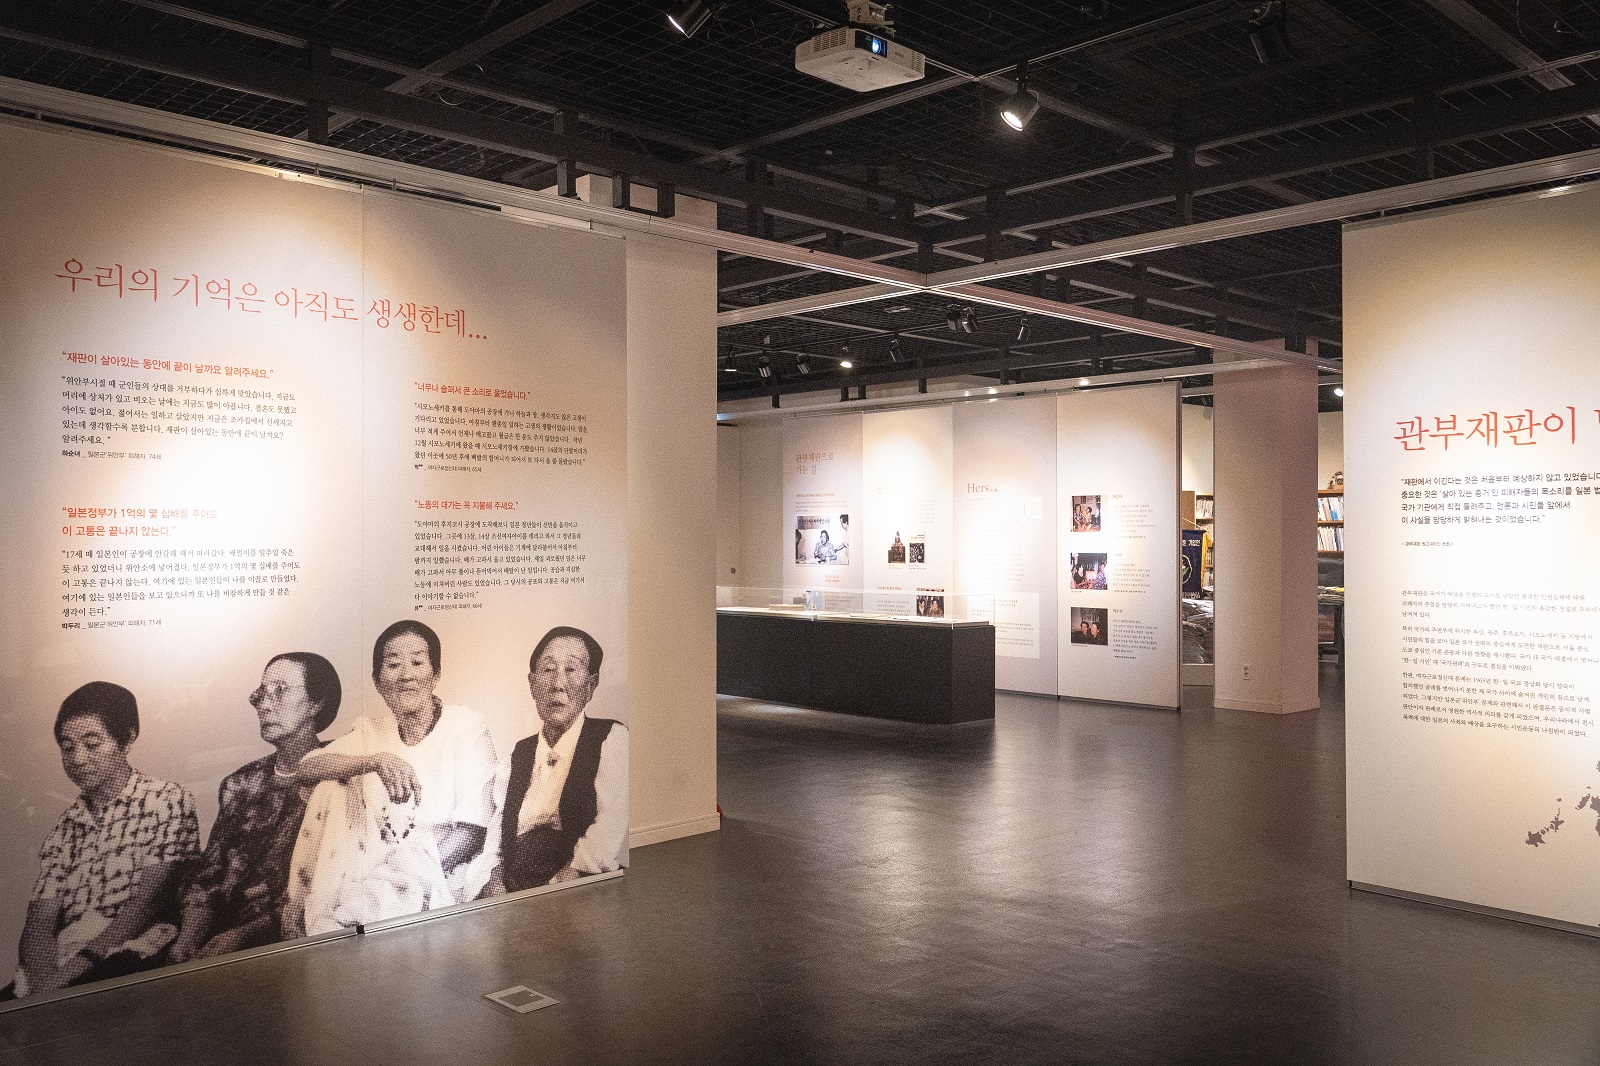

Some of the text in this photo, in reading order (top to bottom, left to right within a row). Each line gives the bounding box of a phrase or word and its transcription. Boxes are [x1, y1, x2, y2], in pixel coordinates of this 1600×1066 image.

[55, 257, 489, 341] 우리의 기억은 아직도 생생한데...
[62, 351, 273, 379] "재판이 살아있는 동안에 끝이 날까요 알려주세요."
[62, 376, 295, 401] "위안부시절 때 군인들의 상대를 거부하다가 심하게 맞았습니다. 지금도
[415, 382, 530, 400] "너무나 슬퍼서 큰 소리로 울었습니다."
[63, 420, 86, 429] 있는데
[89, 421, 128, 431] 생각할수록
[131, 424, 163, 433] 분합니다.
[166, 426, 187, 434] 재판이
[190, 427, 219, 436] 살아있는
[221, 429, 241, 437] 동안에
[244, 430, 257, 438] 끝이
[1393, 405, 1576, 451] 관부재판이
[62, 434, 105, 445] 알려주세요.
[1401, 478, 1431, 486] "재판에서
[1434, 477, 1461, 485] 이긴다는
[1465, 476, 1478, 484] 것은
[1481, 476, 1510, 484] 처음부터
[1513, 475, 1542, 483] 예상하지
[1546, 474, 1561, 482] 않고
[1402, 491, 1422, 499] 중요한
[1424, 490, 1437, 498] 것은
[1459, 490, 1472, 498] 있는
[1501, 488, 1538, 496] 피해자들의
[1542, 487, 1572, 495] 목소리를
[1576, 487, 1591, 495] 일본
[415, 500, 518, 510] "노동의 대가는 꼭 지불해 주세요."
[1418, 503, 1444, 511] 기관에게
[1464, 502, 1494, 510] 들려주고,
[1497, 502, 1519, 510] 언론과
[1522, 502, 1544, 510] 시민들
[1547, 501, 1570, 510] 앞에서
[62, 507, 218, 519] "일본정부가 1억의 몇 십배를 주어도
[1410, 516, 1431, 524] 사실을
[1433, 516, 1460, 524] 당당하게
[1495, 515, 1545, 523] 것이었습니다."
[62, 526, 176, 537] 이 고통은 끝나지 않는다."
[62, 593, 86, 602] 여기에
[89, 593, 105, 602] 있는
[108, 592, 146, 601] 일본인들을
[166, 590, 195, 599] 있으니까
[207, 590, 221, 598] 나를
[223, 589, 250, 597] 비참하게
[269, 588, 274, 596] 것
[277, 588, 290, 596] 같은
[62, 607, 110, 618] 생각이 든다."
